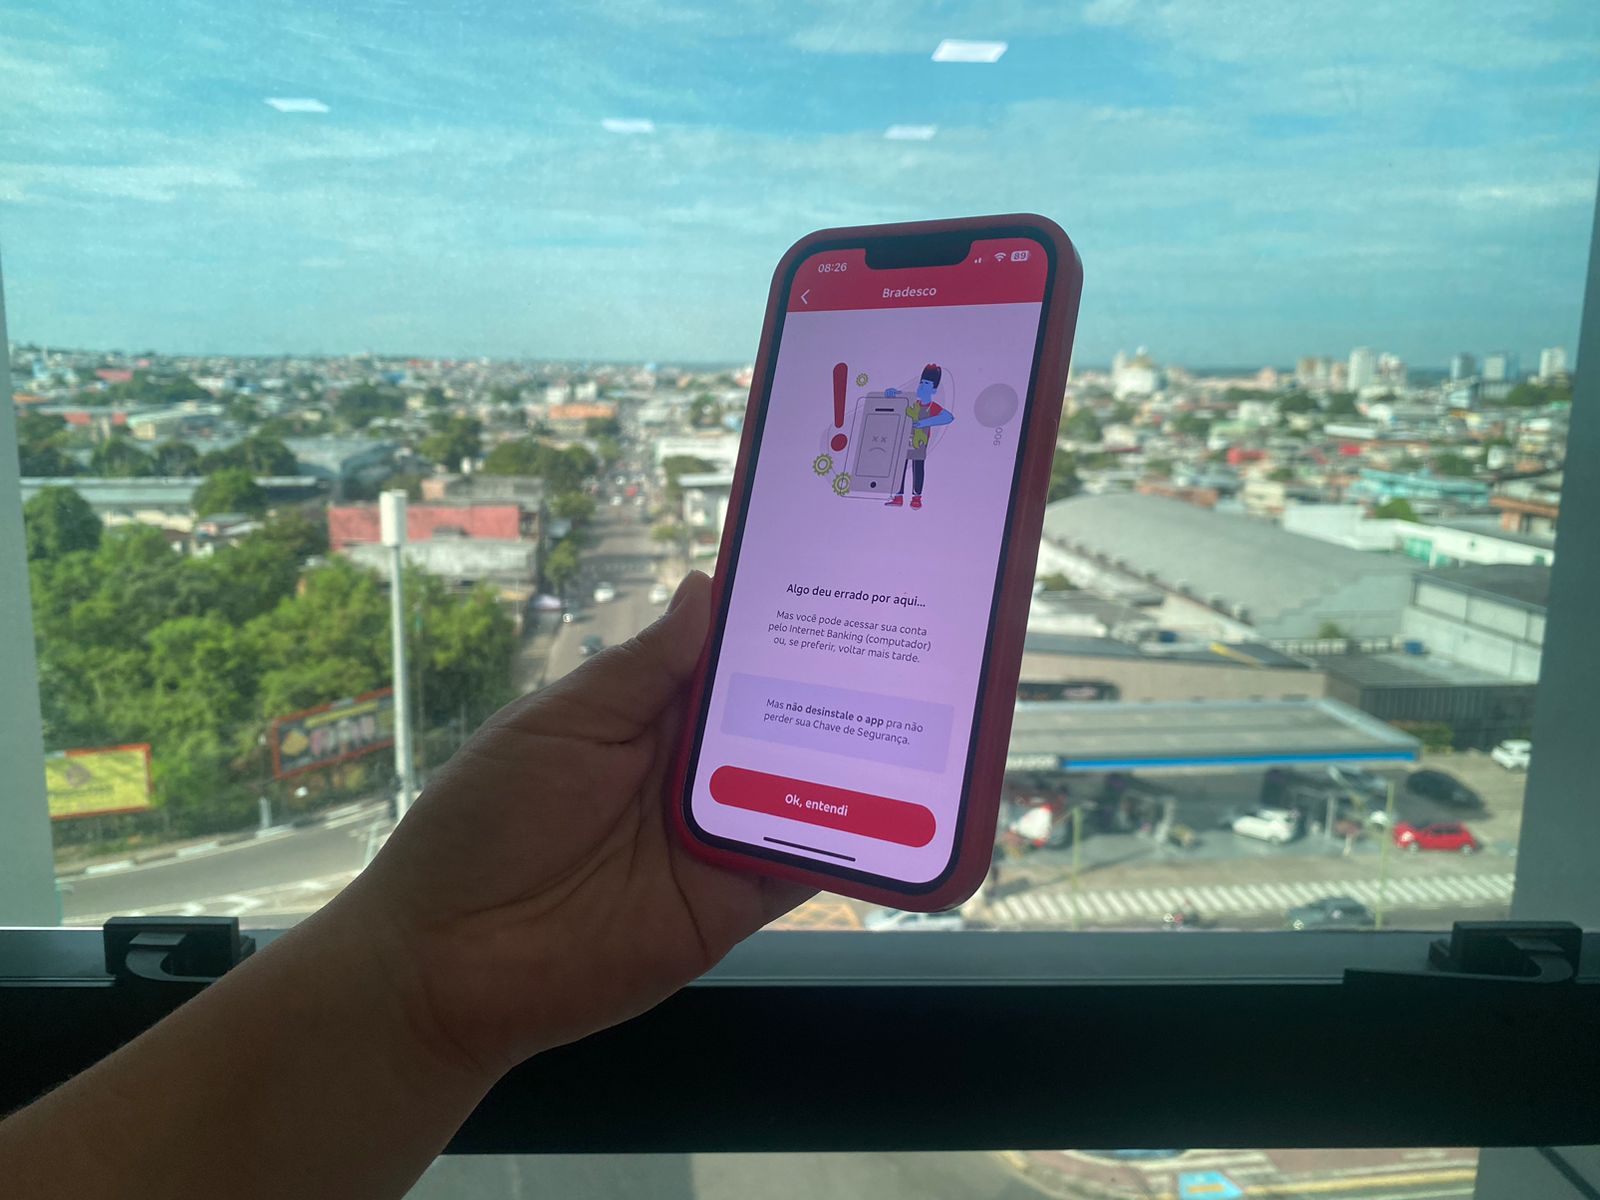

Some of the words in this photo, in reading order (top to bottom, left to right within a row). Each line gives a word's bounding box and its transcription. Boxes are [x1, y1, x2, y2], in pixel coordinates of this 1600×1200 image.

[818, 262, 847, 273] 08:26
[1013, 252, 1027, 260] 89
[882, 286, 937, 298] Bradesco
[786, 583, 810, 597] Algo
[812, 586, 832, 597] deu
[834, 589, 869, 601] errado
[871, 593, 891, 604] por
[893, 595, 926, 608] aqui...
[776, 610, 794, 621] Mas
[796, 612, 817, 623] você
[818, 615, 842, 627] pode
[844, 619, 879, 630] acessar
[881, 623, 897, 633] sua
[900, 625, 927, 636] conta
[768, 622, 788, 633] pelo
[789, 625, 825, 637] Internet
[826, 629, 864, 644] Banking
[865, 634, 932, 652] (computador)
[773, 636, 787, 646] ou,
[789, 639, 799, 647] se
[800, 639, 836, 652] preferir,
[838, 644, 866, 656] voltar
[867, 648, 890, 659] mais
[892, 651, 920, 663] tarde.
[766, 698, 784, 710] Mas
[785, 702, 803, 713] não
[805, 704, 854, 721] desinstale
[856, 714, 863, 722] o
[865, 716, 884, 727] app
[885, 719, 902, 730] pra
[904, 721, 923, 733] não
[763, 712, 793, 725] perder
[795, 717, 811, 728] sua
[813, 719, 841, 733] Chave
[843, 724, 855, 735] de
[857, 726, 910, 745] Segurança.
[784, 793, 803, 808] Ok,
[805, 799, 849, 817] entendi
